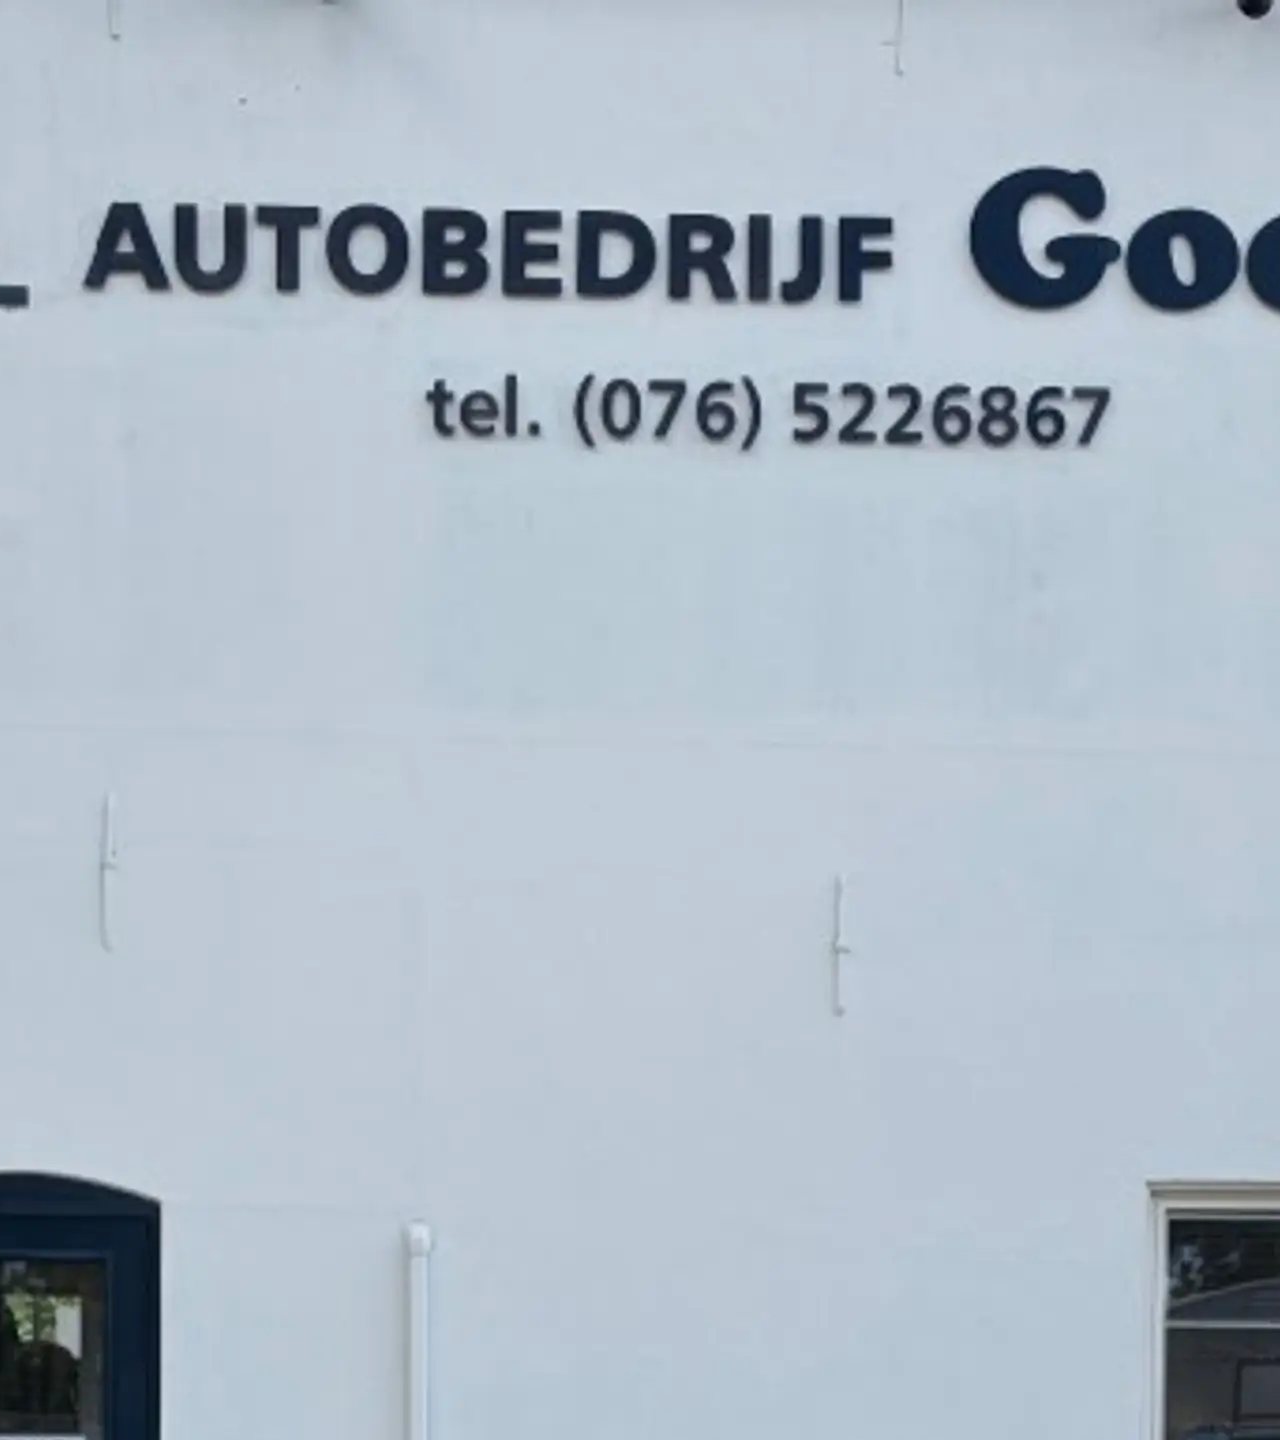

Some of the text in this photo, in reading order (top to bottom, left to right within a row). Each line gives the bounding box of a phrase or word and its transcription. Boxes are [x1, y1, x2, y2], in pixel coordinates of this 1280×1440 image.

[83, 202, 894, 306] AUTOBEDRIJF
[425, 374, 1111, 451] tel. (076) 5226867
